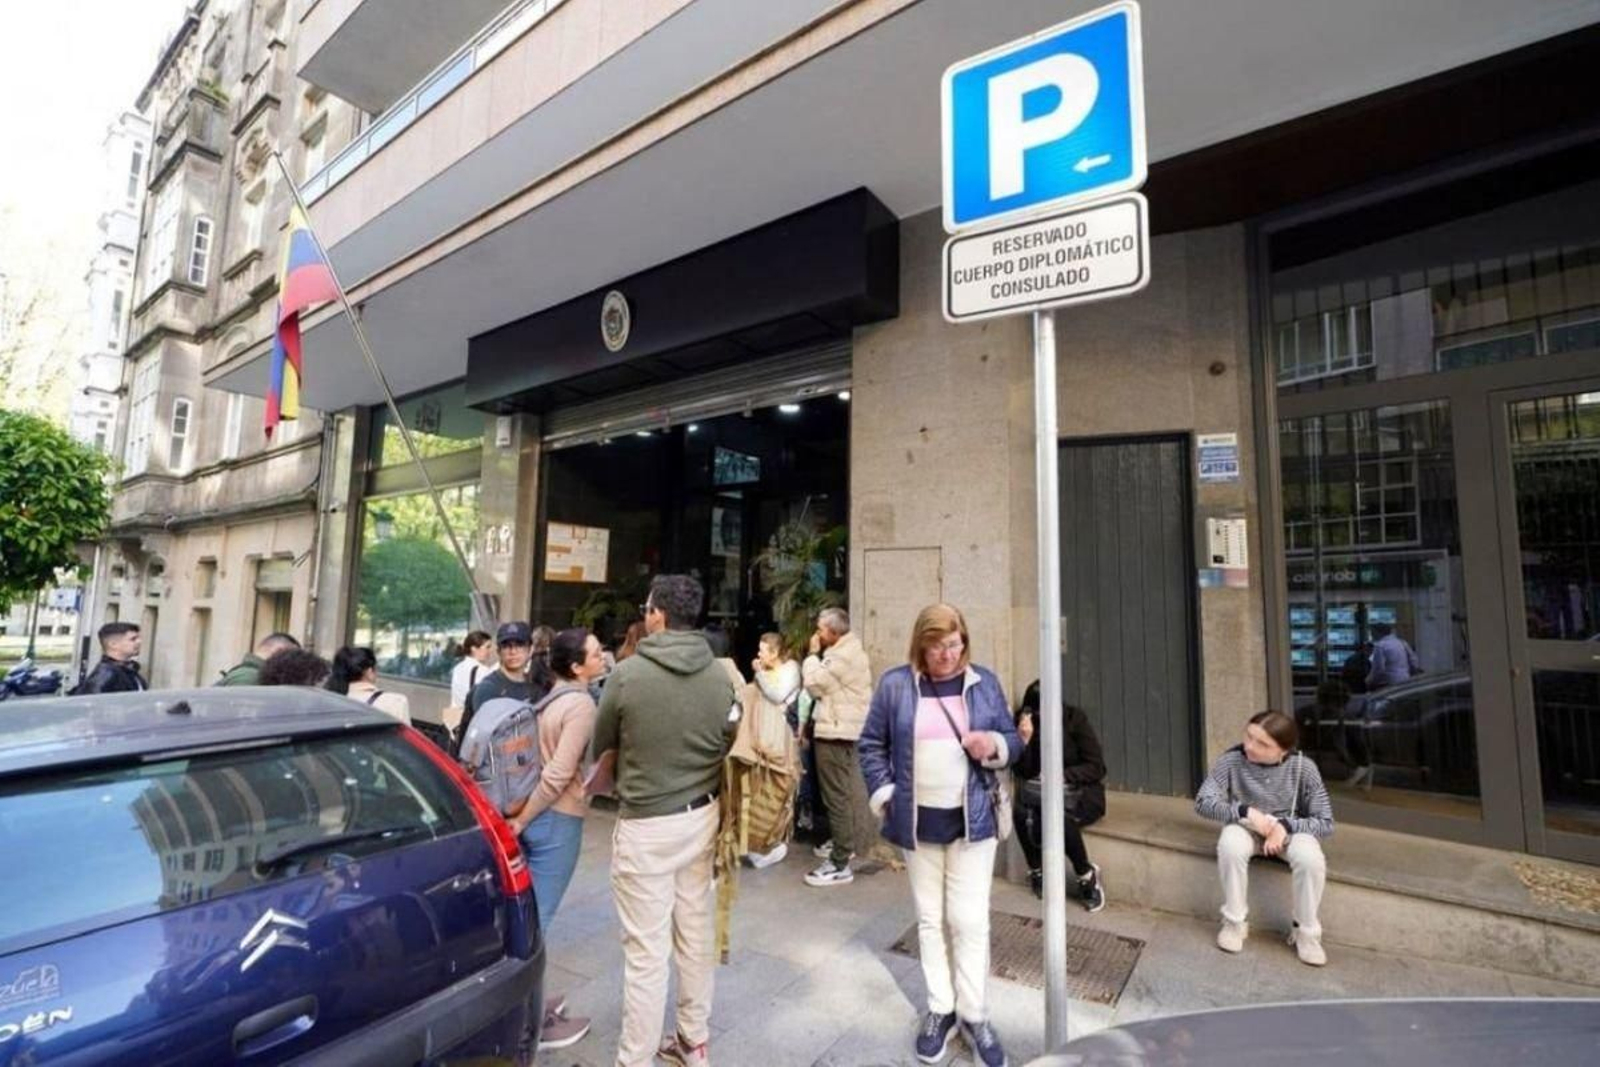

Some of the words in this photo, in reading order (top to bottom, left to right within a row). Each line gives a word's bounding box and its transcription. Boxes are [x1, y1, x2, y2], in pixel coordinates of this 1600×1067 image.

[988, 52, 1100, 201] P
[954, 260, 1014, 285] CUERPO
[1019, 235, 1134, 272] DIPLOMÁTICO
[992, 222, 1087, 256] RESERVADO
[991, 267, 1090, 299] CONSULADO
